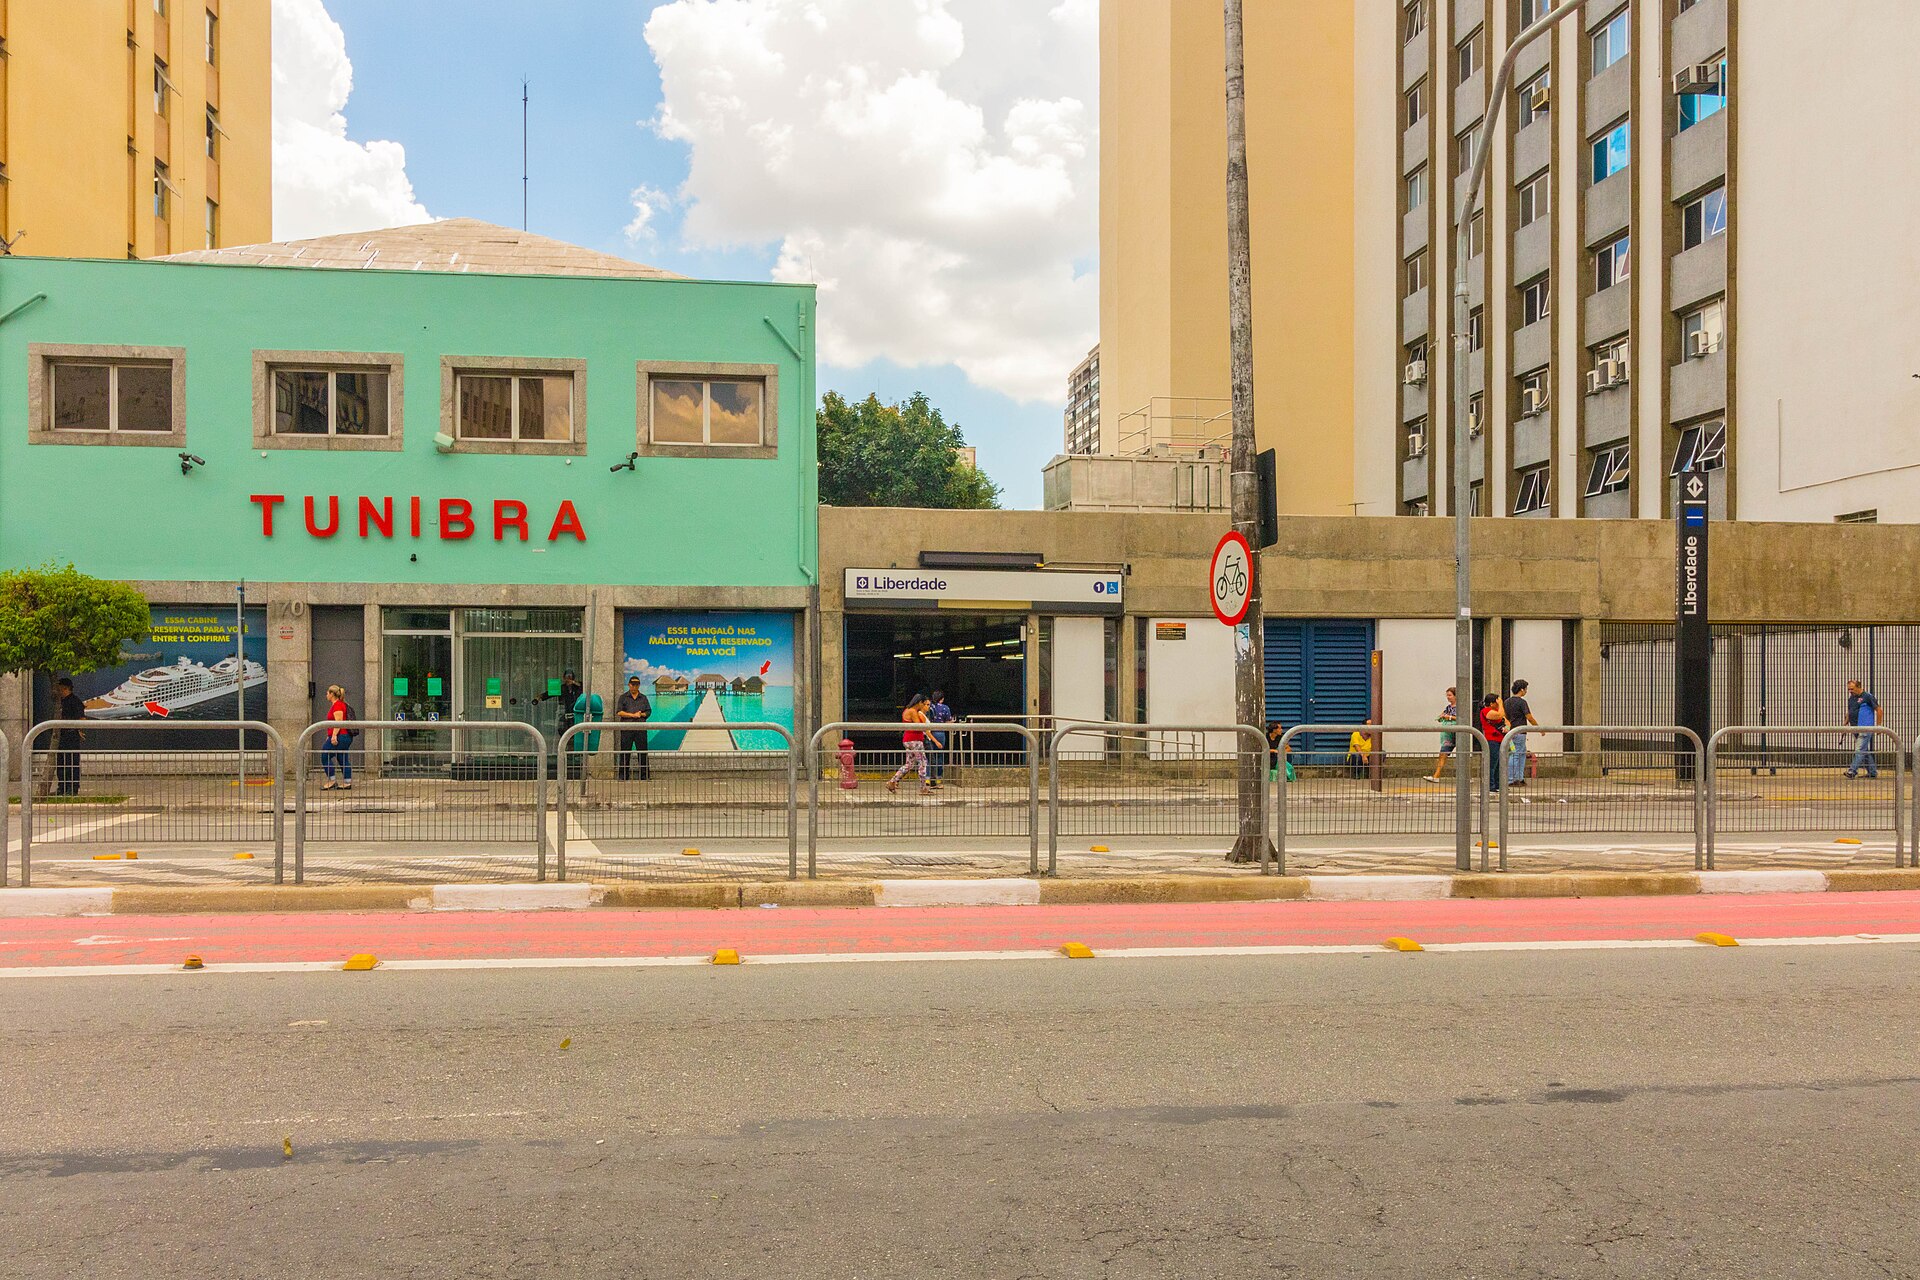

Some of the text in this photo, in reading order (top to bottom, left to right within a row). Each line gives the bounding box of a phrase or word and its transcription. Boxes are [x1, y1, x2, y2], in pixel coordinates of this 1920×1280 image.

[250, 494, 587, 541] TUNIBRA
[1684, 536, 1698, 615] Liberdade
[874, 577, 947, 590] Liberdade
[226, 624, 249, 633] VOÊ
[667, 627, 688, 635] ESSE
[737, 627, 756, 635] NAS
[187, 635, 231, 643] CONFIRME
[648, 635, 772, 646] MALDIVAS ESTÁ RESERVADO
[686, 646, 736, 656] PARA VOCÊ
